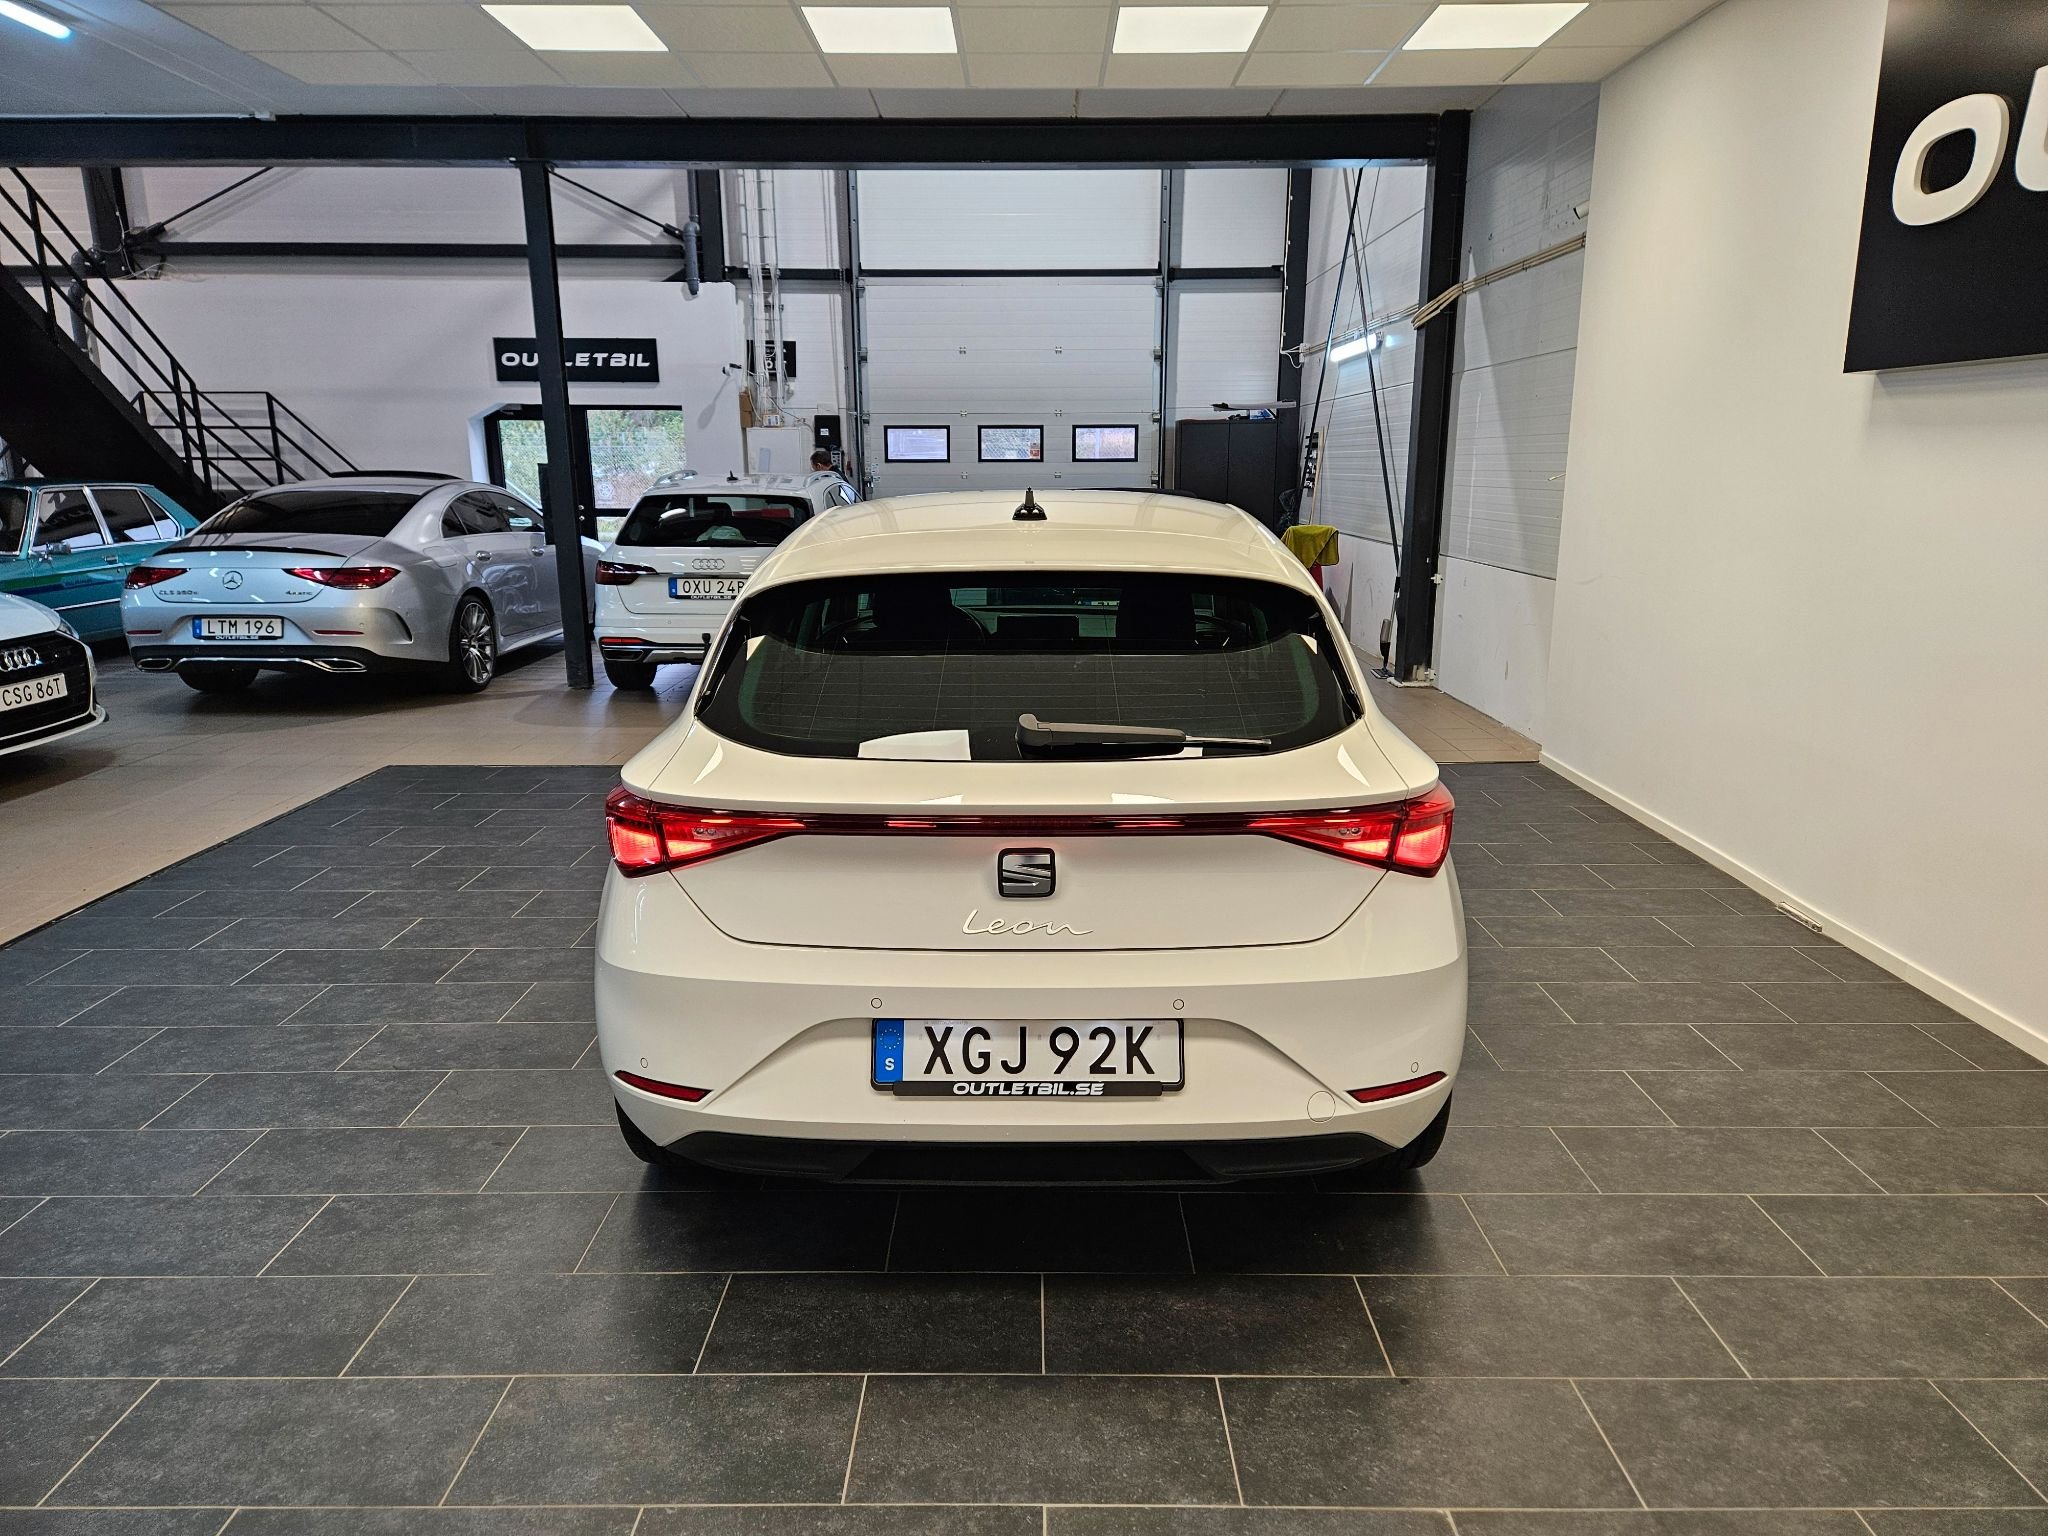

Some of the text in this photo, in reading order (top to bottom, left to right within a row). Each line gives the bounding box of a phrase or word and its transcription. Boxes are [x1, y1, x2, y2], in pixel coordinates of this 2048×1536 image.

[501, 352, 651, 367] OUETBIL
[683, 580, 711, 594] OXU
[207, 620, 238, 634] LTM
[244, 620, 275, 634] 196
[3, 678, 60, 706] CSG 86T
[962, 909, 1094, 935] Leon
[923, 1026, 1155, 1075] XGJ 92K
[884, 1058, 895, 1071] S
[953, 1082, 1104, 1096] OUTLETBIL.SE
